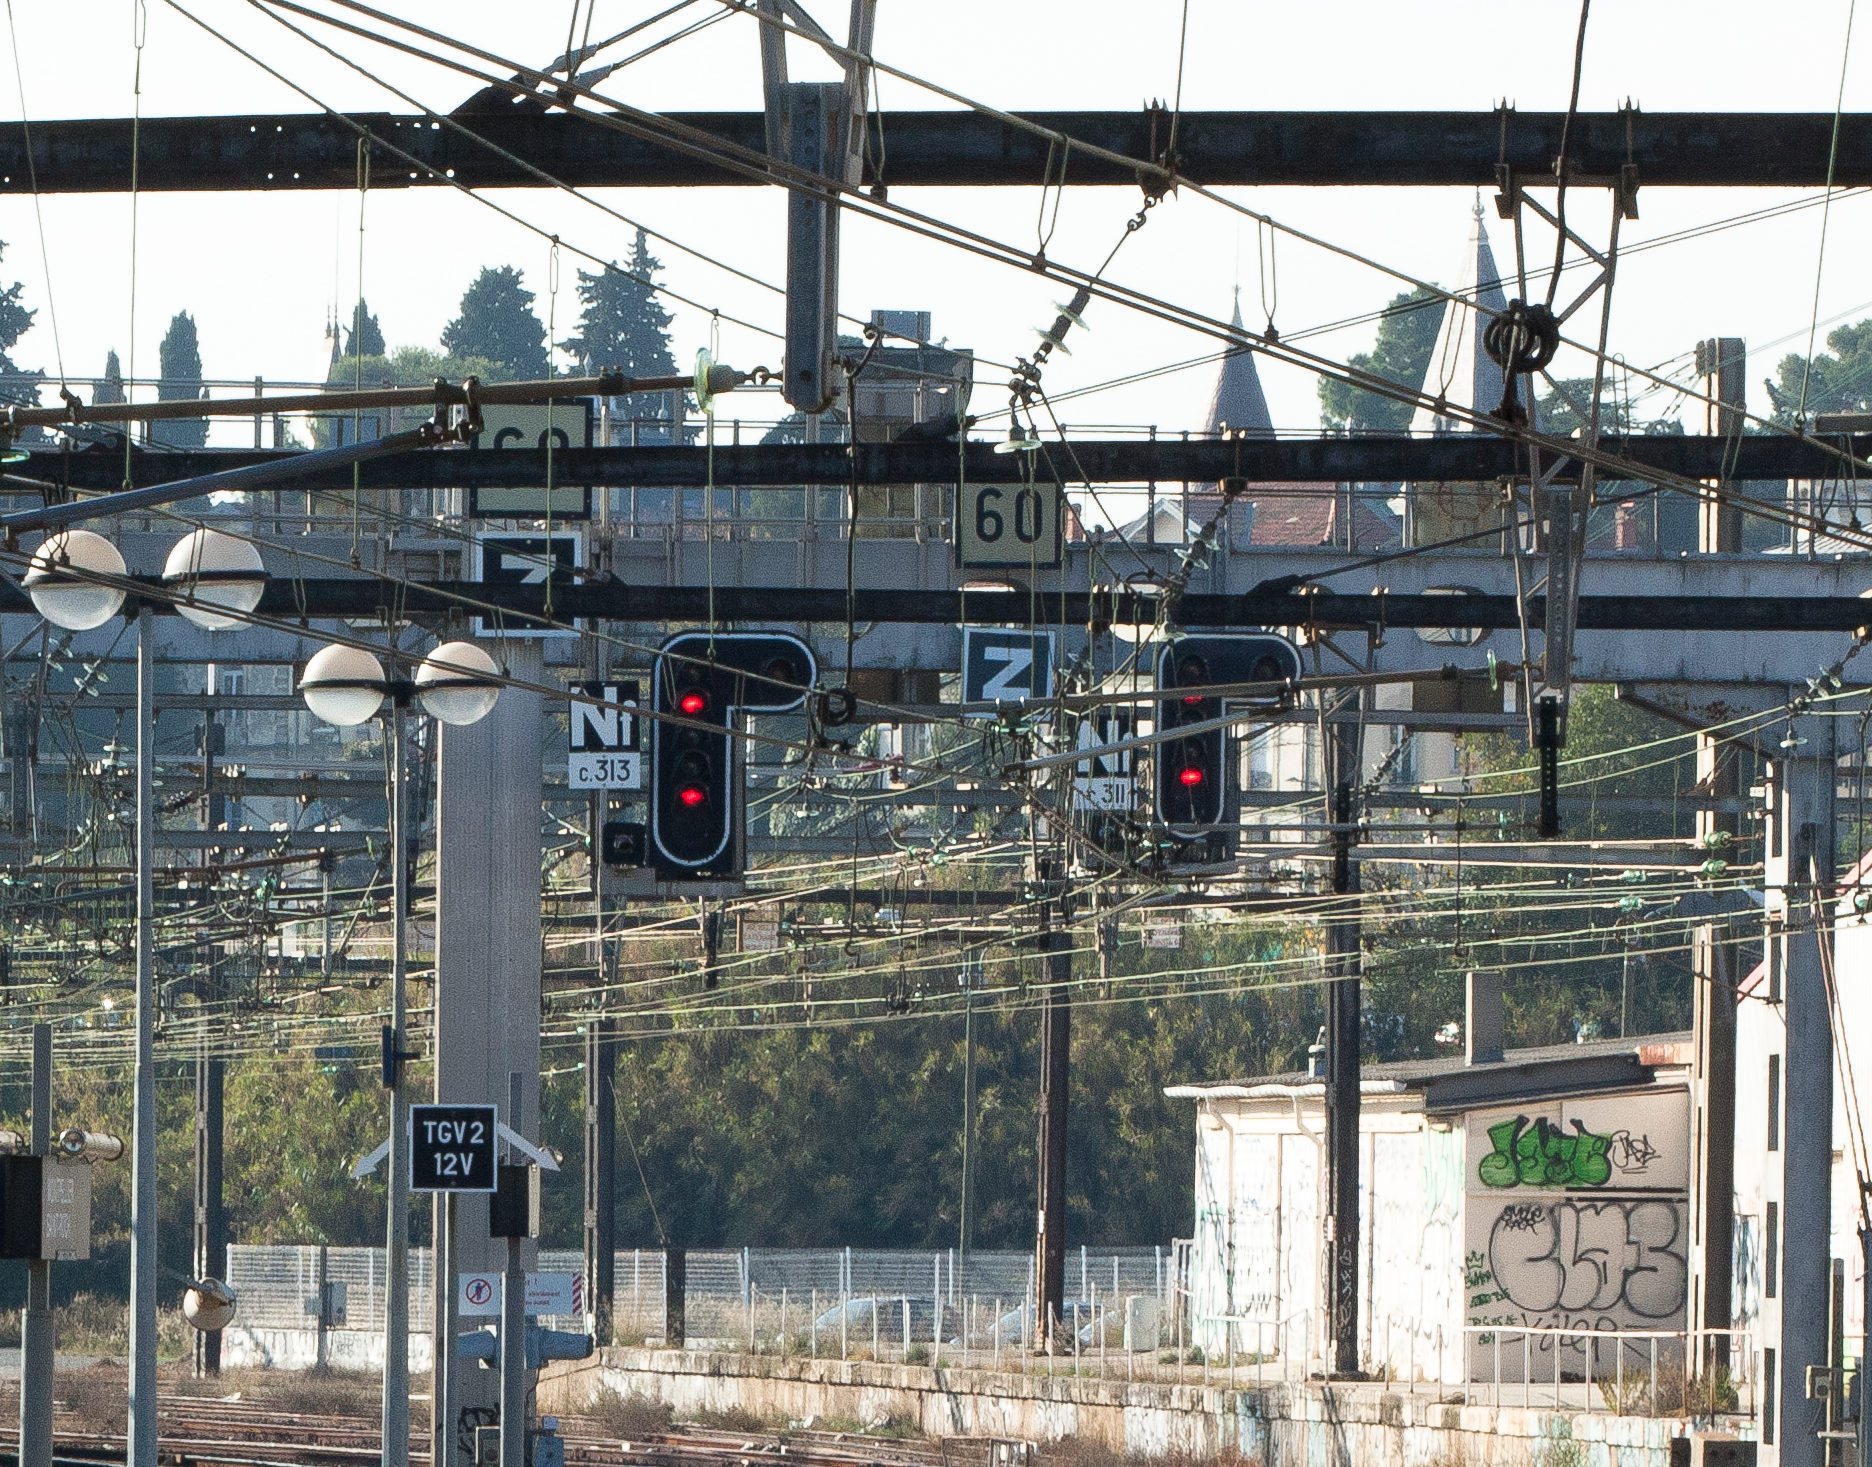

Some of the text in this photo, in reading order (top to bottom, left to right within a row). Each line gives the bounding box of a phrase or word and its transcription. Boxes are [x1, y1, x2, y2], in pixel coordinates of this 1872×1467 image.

[976, 486, 1043, 544] 60
[982, 646, 1034, 699] Z
[571, 686, 637, 747] Nf
[579, 758, 630, 782] c.313
[424, 1121, 466, 1145] TGV
[434, 1152, 474, 1176] 12V
